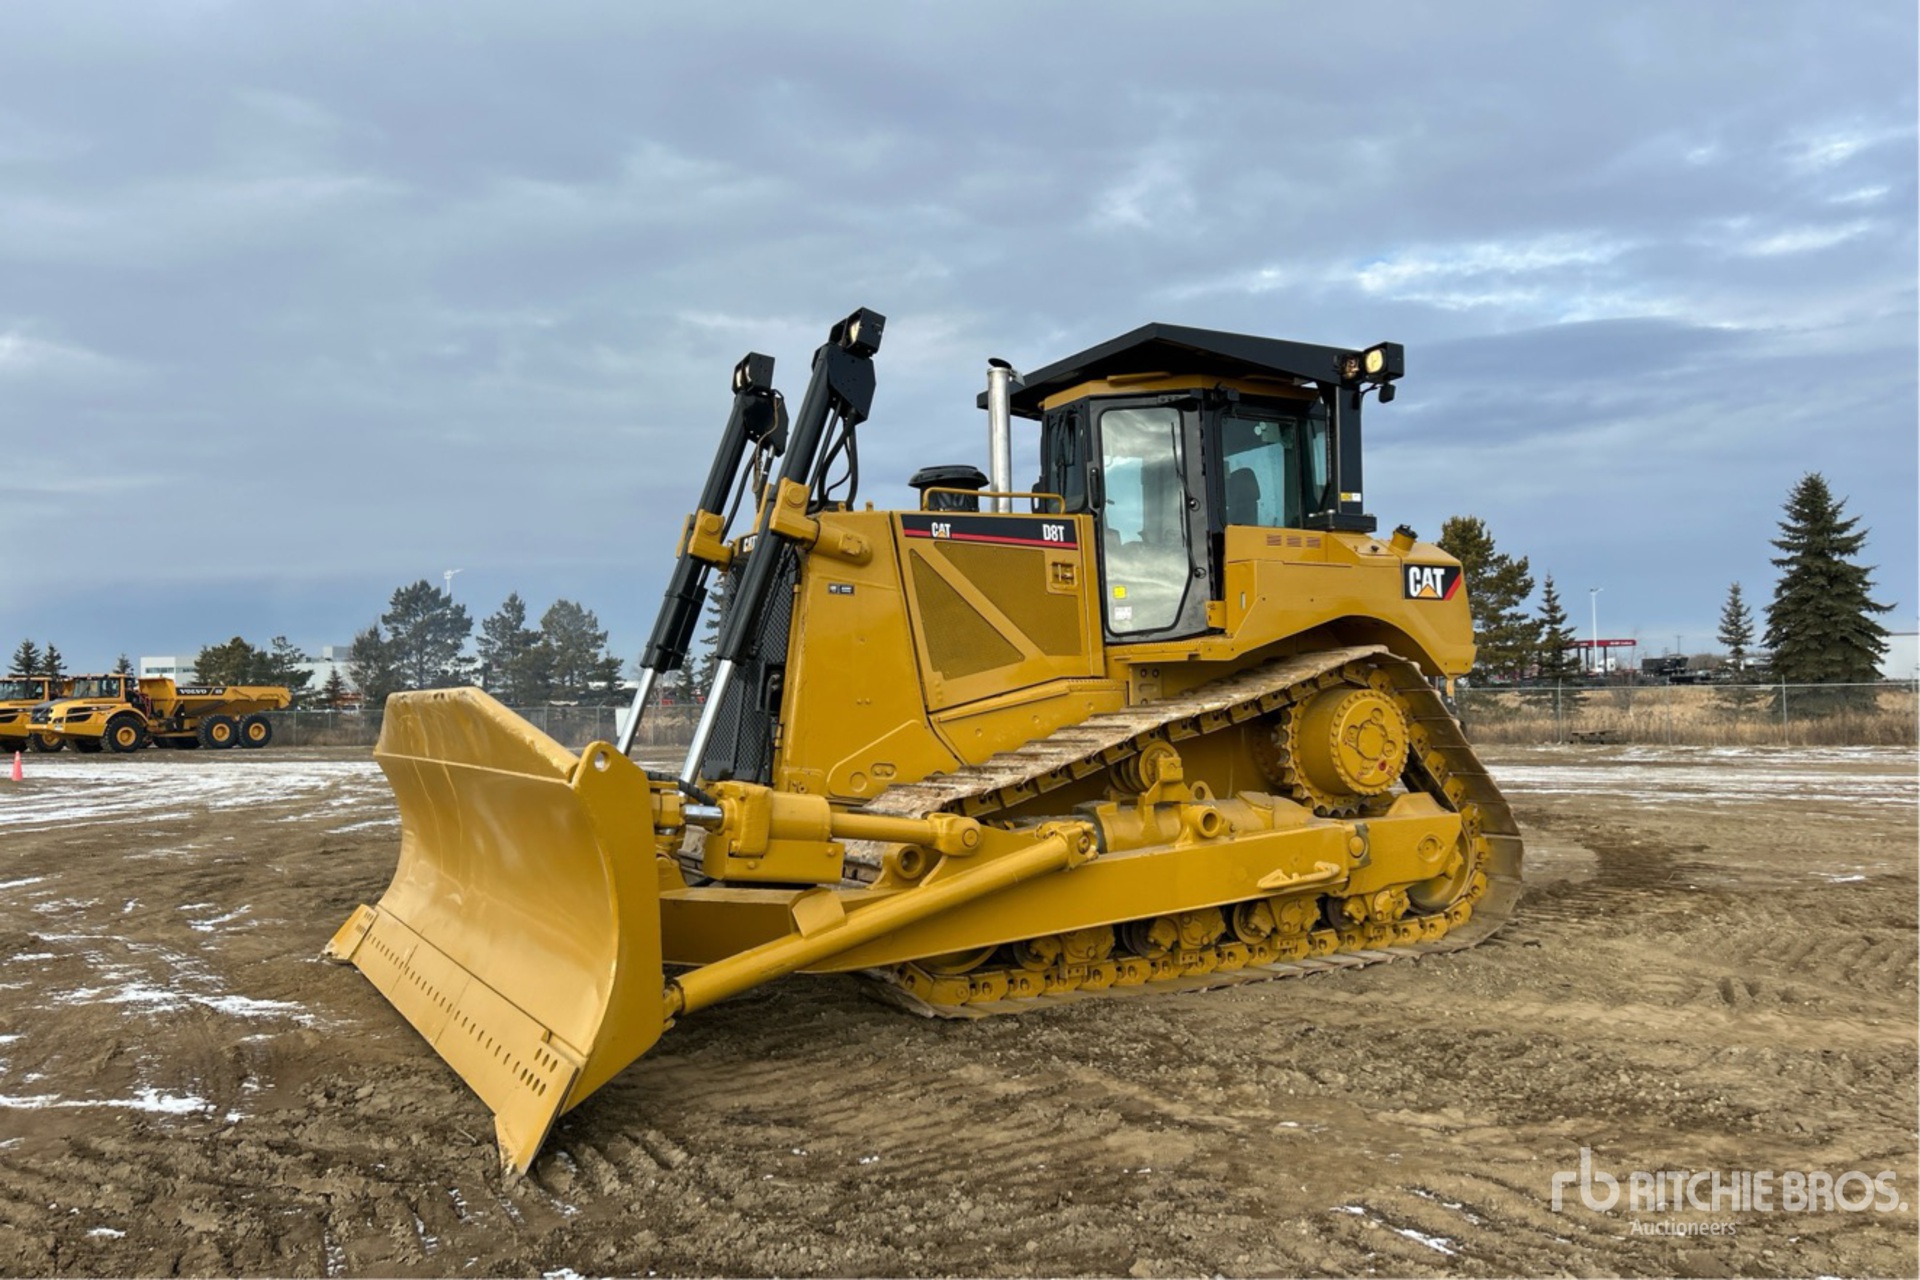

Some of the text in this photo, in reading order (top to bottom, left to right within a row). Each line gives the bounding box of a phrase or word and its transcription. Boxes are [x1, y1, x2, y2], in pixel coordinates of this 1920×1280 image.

[931, 522, 951, 538] CAT
[1042, 524, 1065, 542] D8T
[1409, 566, 1445, 598] CAT
